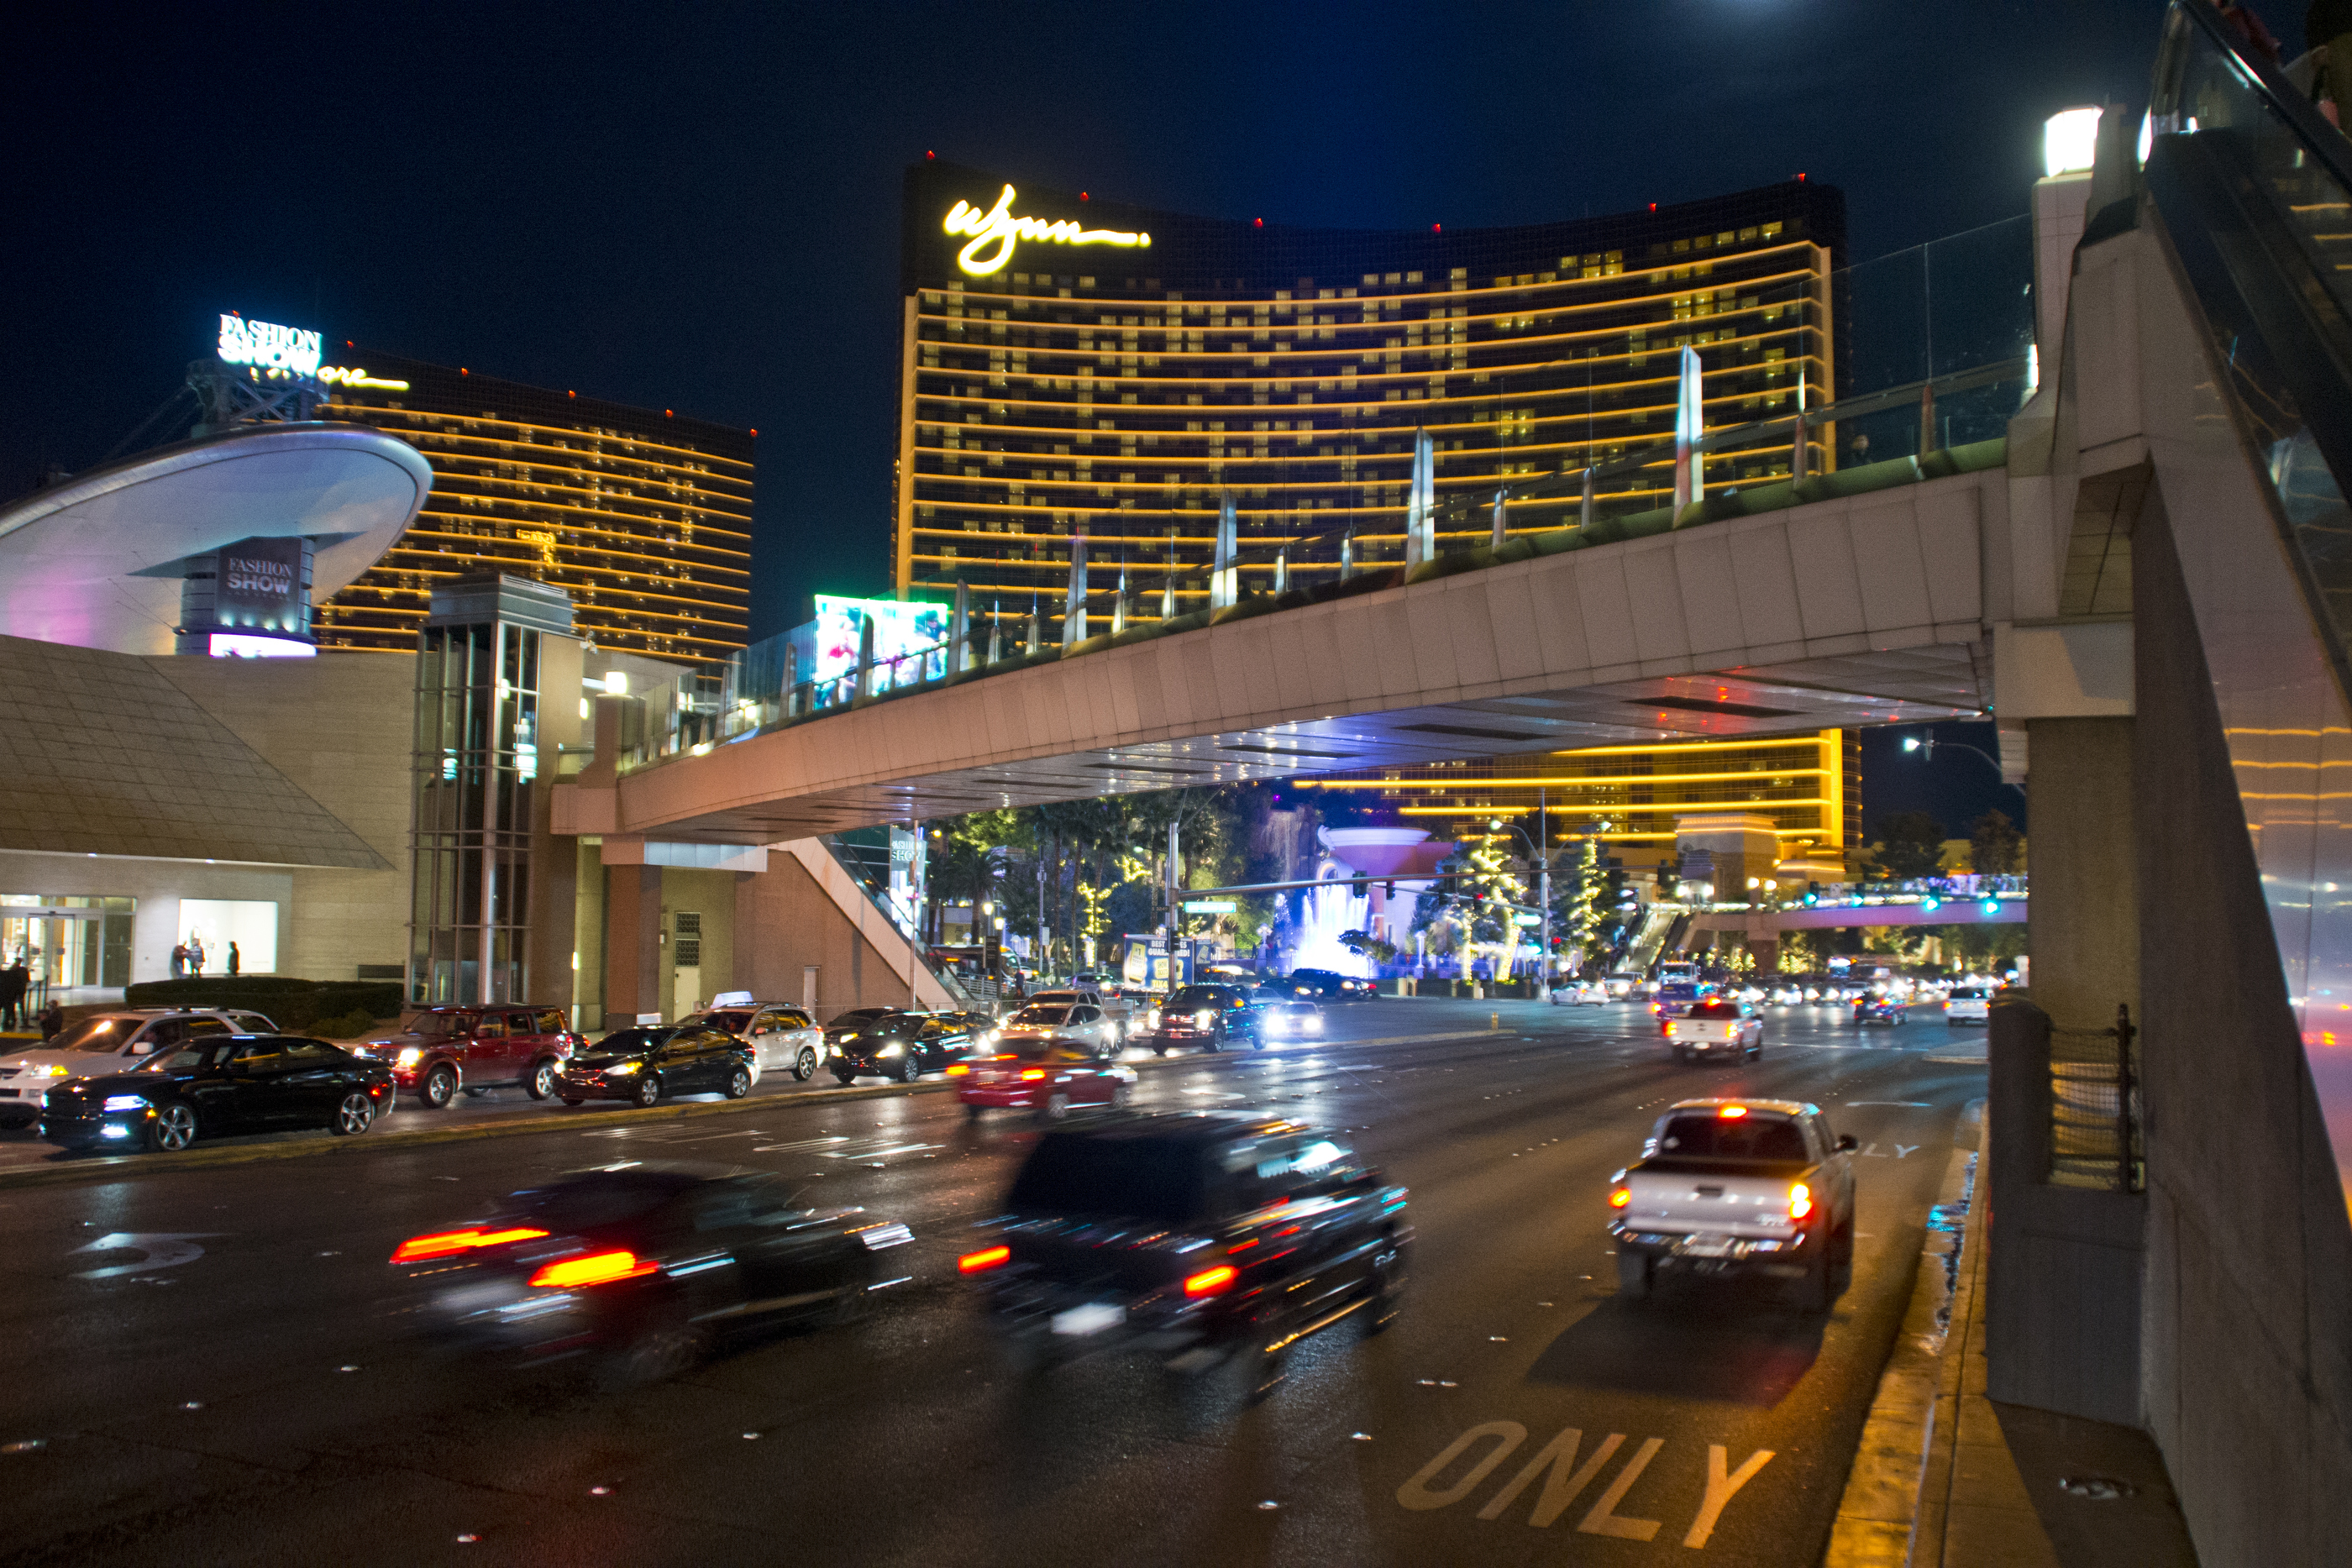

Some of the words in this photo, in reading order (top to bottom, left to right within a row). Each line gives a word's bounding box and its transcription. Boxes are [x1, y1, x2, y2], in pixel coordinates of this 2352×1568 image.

[219, 313, 323, 352] FASHION
[217, 334, 322, 377] SHOW
[227, 573, 290, 594] SHOW
[228, 558, 293, 577] FASHION
[1395, 1419, 1777, 1550] ONLY
